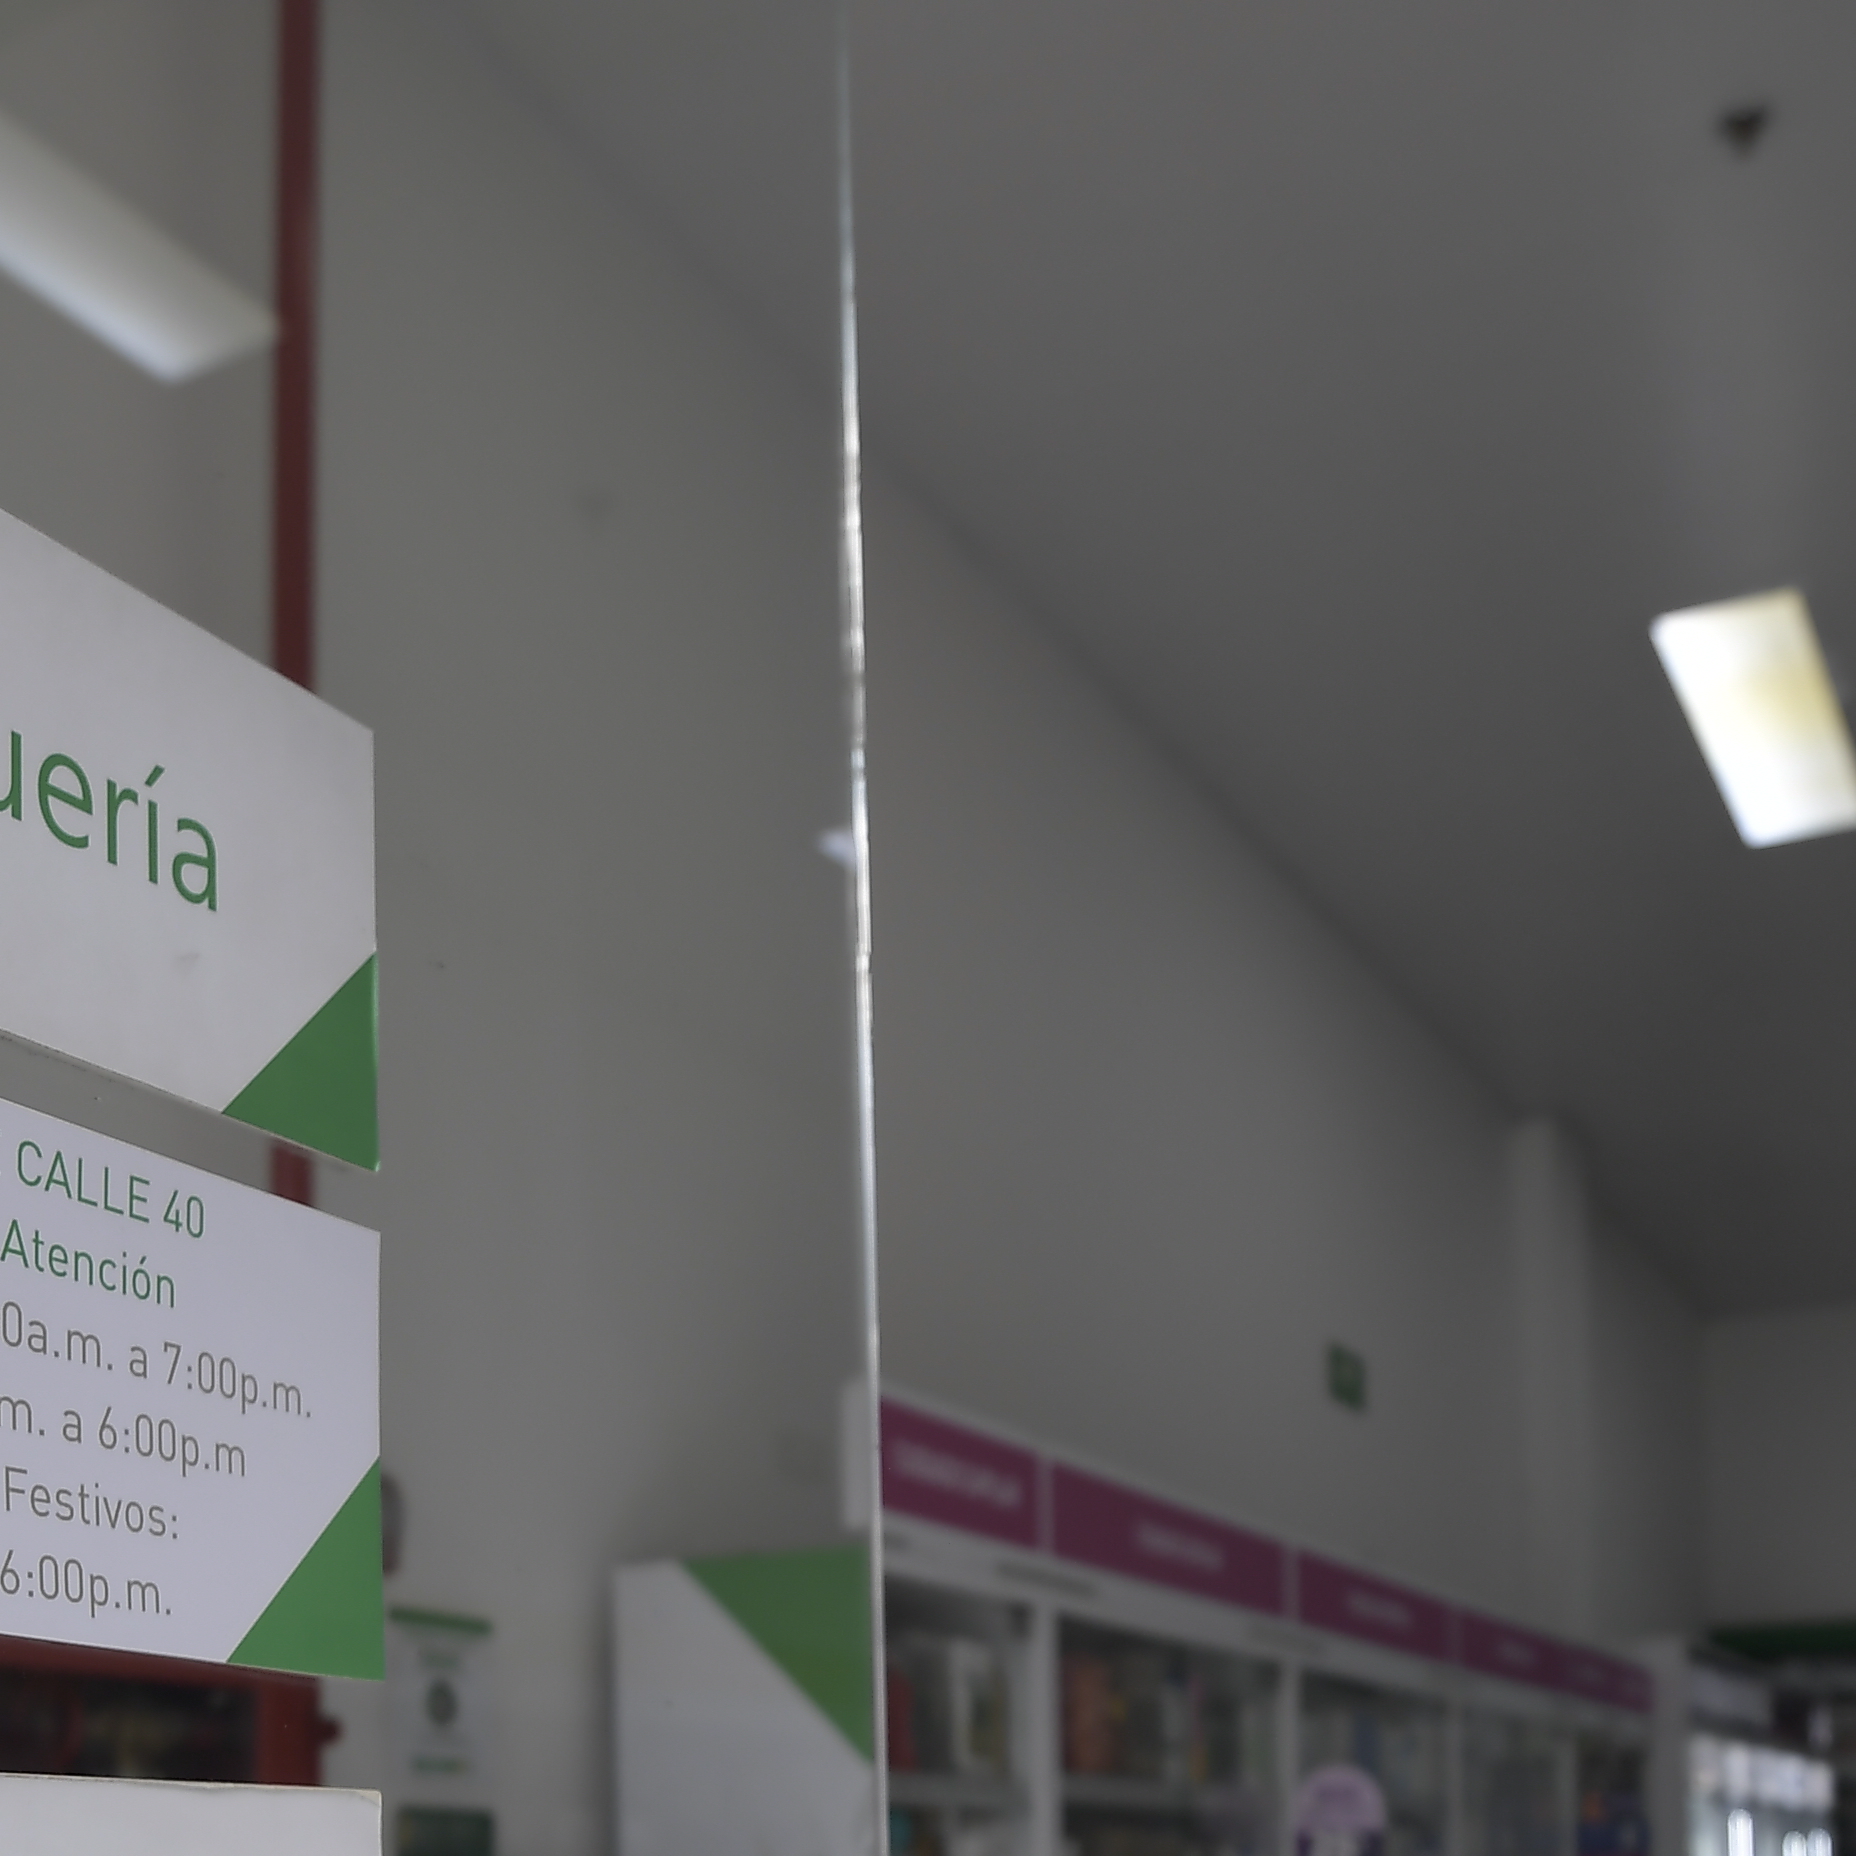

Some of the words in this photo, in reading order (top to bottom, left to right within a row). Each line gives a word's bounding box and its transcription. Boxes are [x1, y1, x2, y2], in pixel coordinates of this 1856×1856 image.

[16, 1139, 151, 1224] CALLE
[162, 1189, 205, 1239] 40
[0, 1217, 176, 1308] Atención
[128, 1343, 149, 1379] a
[162, 1341, 312, 1419] 7:00p.m.
[61, 1407, 83, 1445] a
[97, 1405, 246, 1478] 6:00p.m
[3, 1465, 180, 1540] Festivos:
